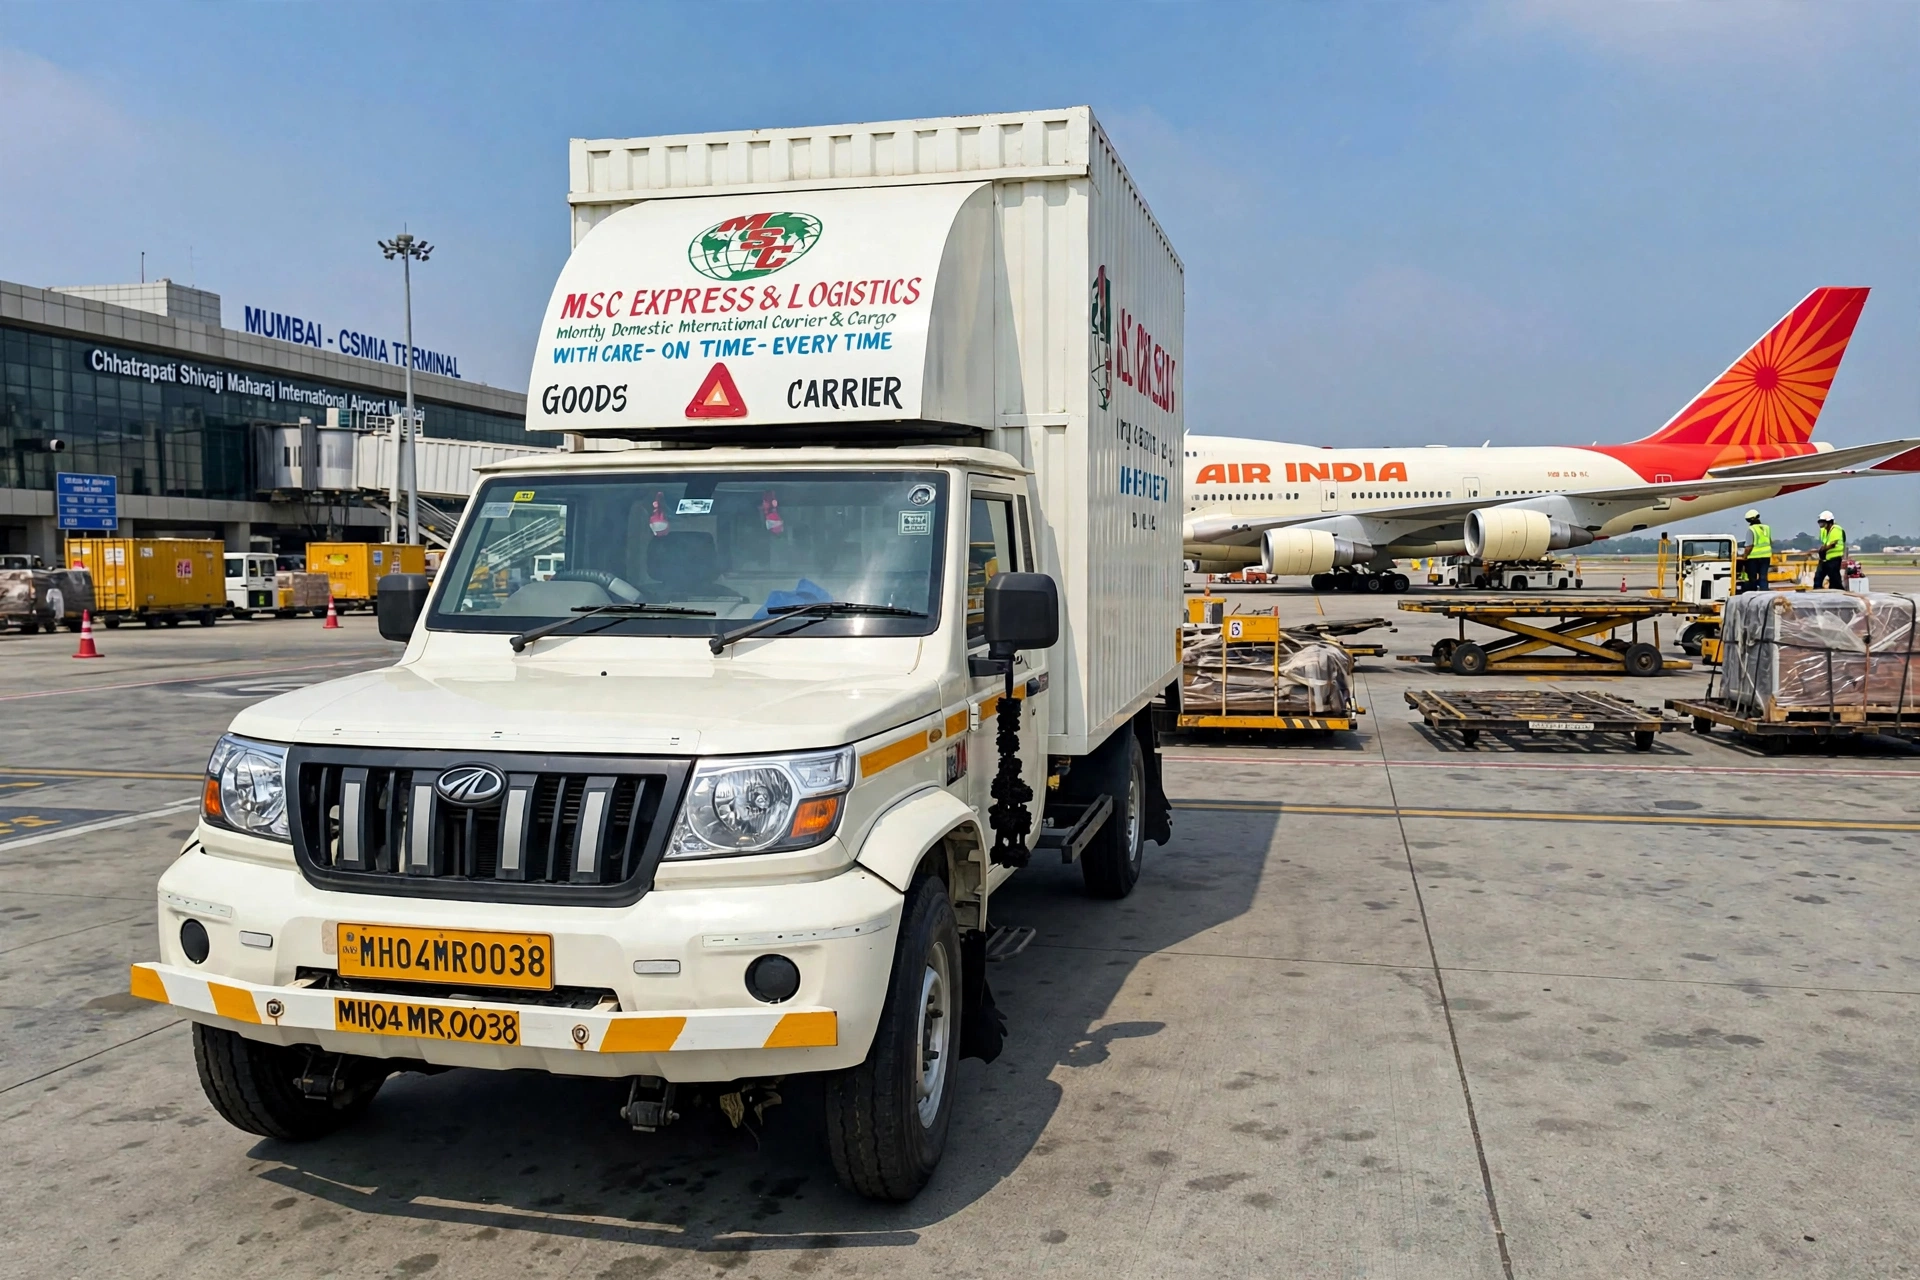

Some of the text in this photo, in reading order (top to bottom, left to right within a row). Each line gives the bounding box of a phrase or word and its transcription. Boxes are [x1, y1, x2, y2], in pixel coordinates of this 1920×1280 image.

[560, 291, 623, 319] MSC
[629, 285, 755, 317] EXPRESS
[787, 277, 922, 309] LOGISTICS
[245, 306, 322, 348] MUMBAI
[339, 329, 389, 363] CSMIA
[392, 341, 461, 379] TERMINAL
[612, 321, 673, 337] Domestic
[678, 316, 768, 333] International
[829, 311, 844, 327] &
[846, 311, 897, 330] Cargo
[553, 346, 599, 364] WITH
[662, 341, 690, 359] ON
[772, 334, 838, 355] EVERY
[844, 332, 893, 351] TIME
[91, 349, 176, 383] Chhatrapati
[180, 364, 223, 394] Shivaji
[227, 372, 275, 402] Maharaj
[278, 381, 347, 409] International
[350, 395, 386, 416] Airport
[542, 376, 903, 415] GOODS CARRIER
[1195, 462, 1408, 484] AIR INDIA
[360, 935, 546, 977] MH04MR0038
